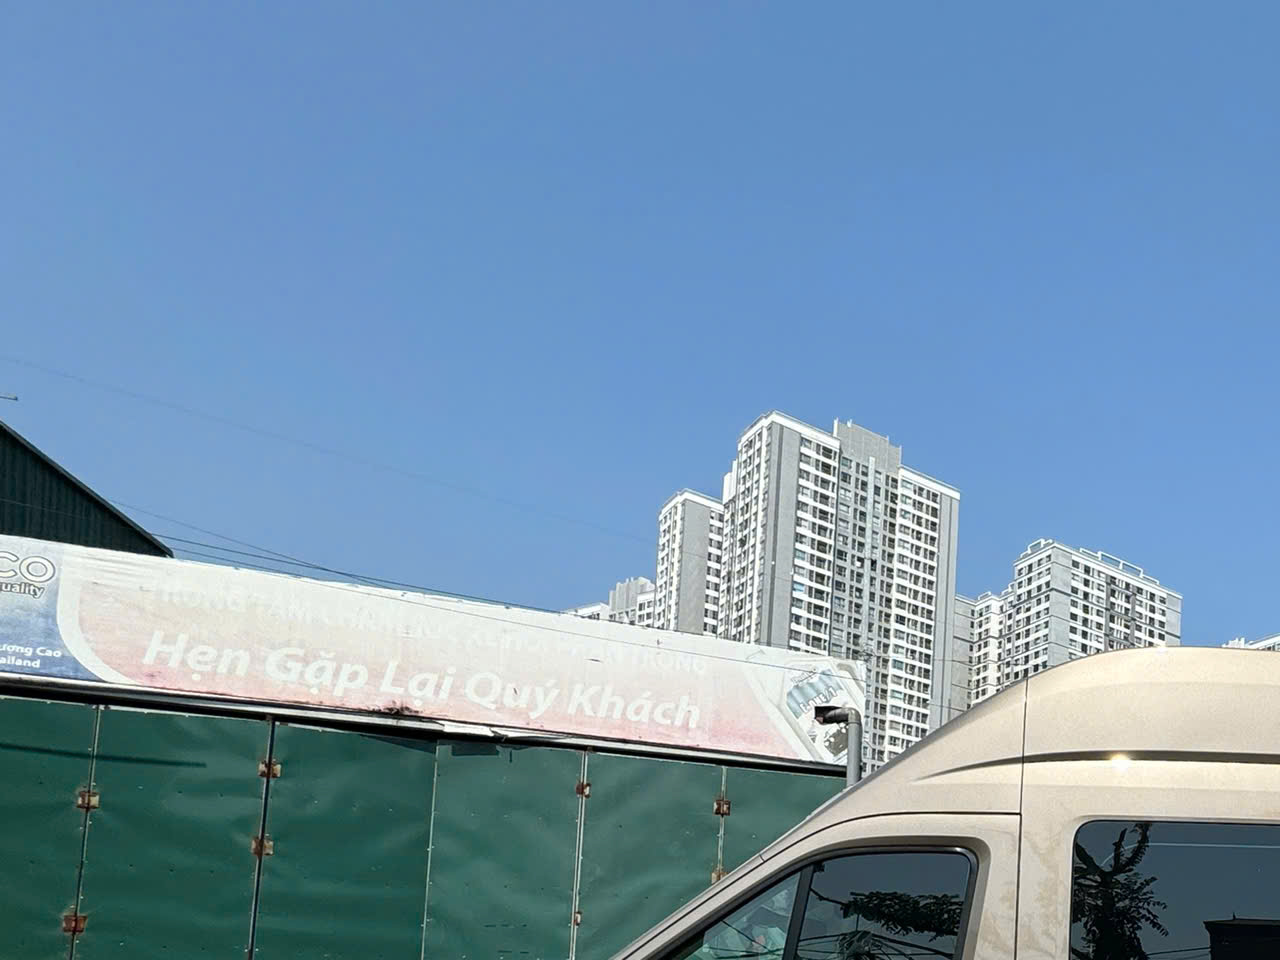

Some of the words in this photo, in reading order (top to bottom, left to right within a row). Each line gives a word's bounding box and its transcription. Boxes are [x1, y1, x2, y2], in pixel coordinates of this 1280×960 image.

[0, 582, 45, 599] uality
[36, 646, 62, 658] Cao
[141, 630, 250, 681] Hẹn
[264, 647, 369, 697] Gặp
[379, 659, 457, 706] Lại
[464, 671, 560, 719] Quý
[567, 682, 701, 728] Khách
